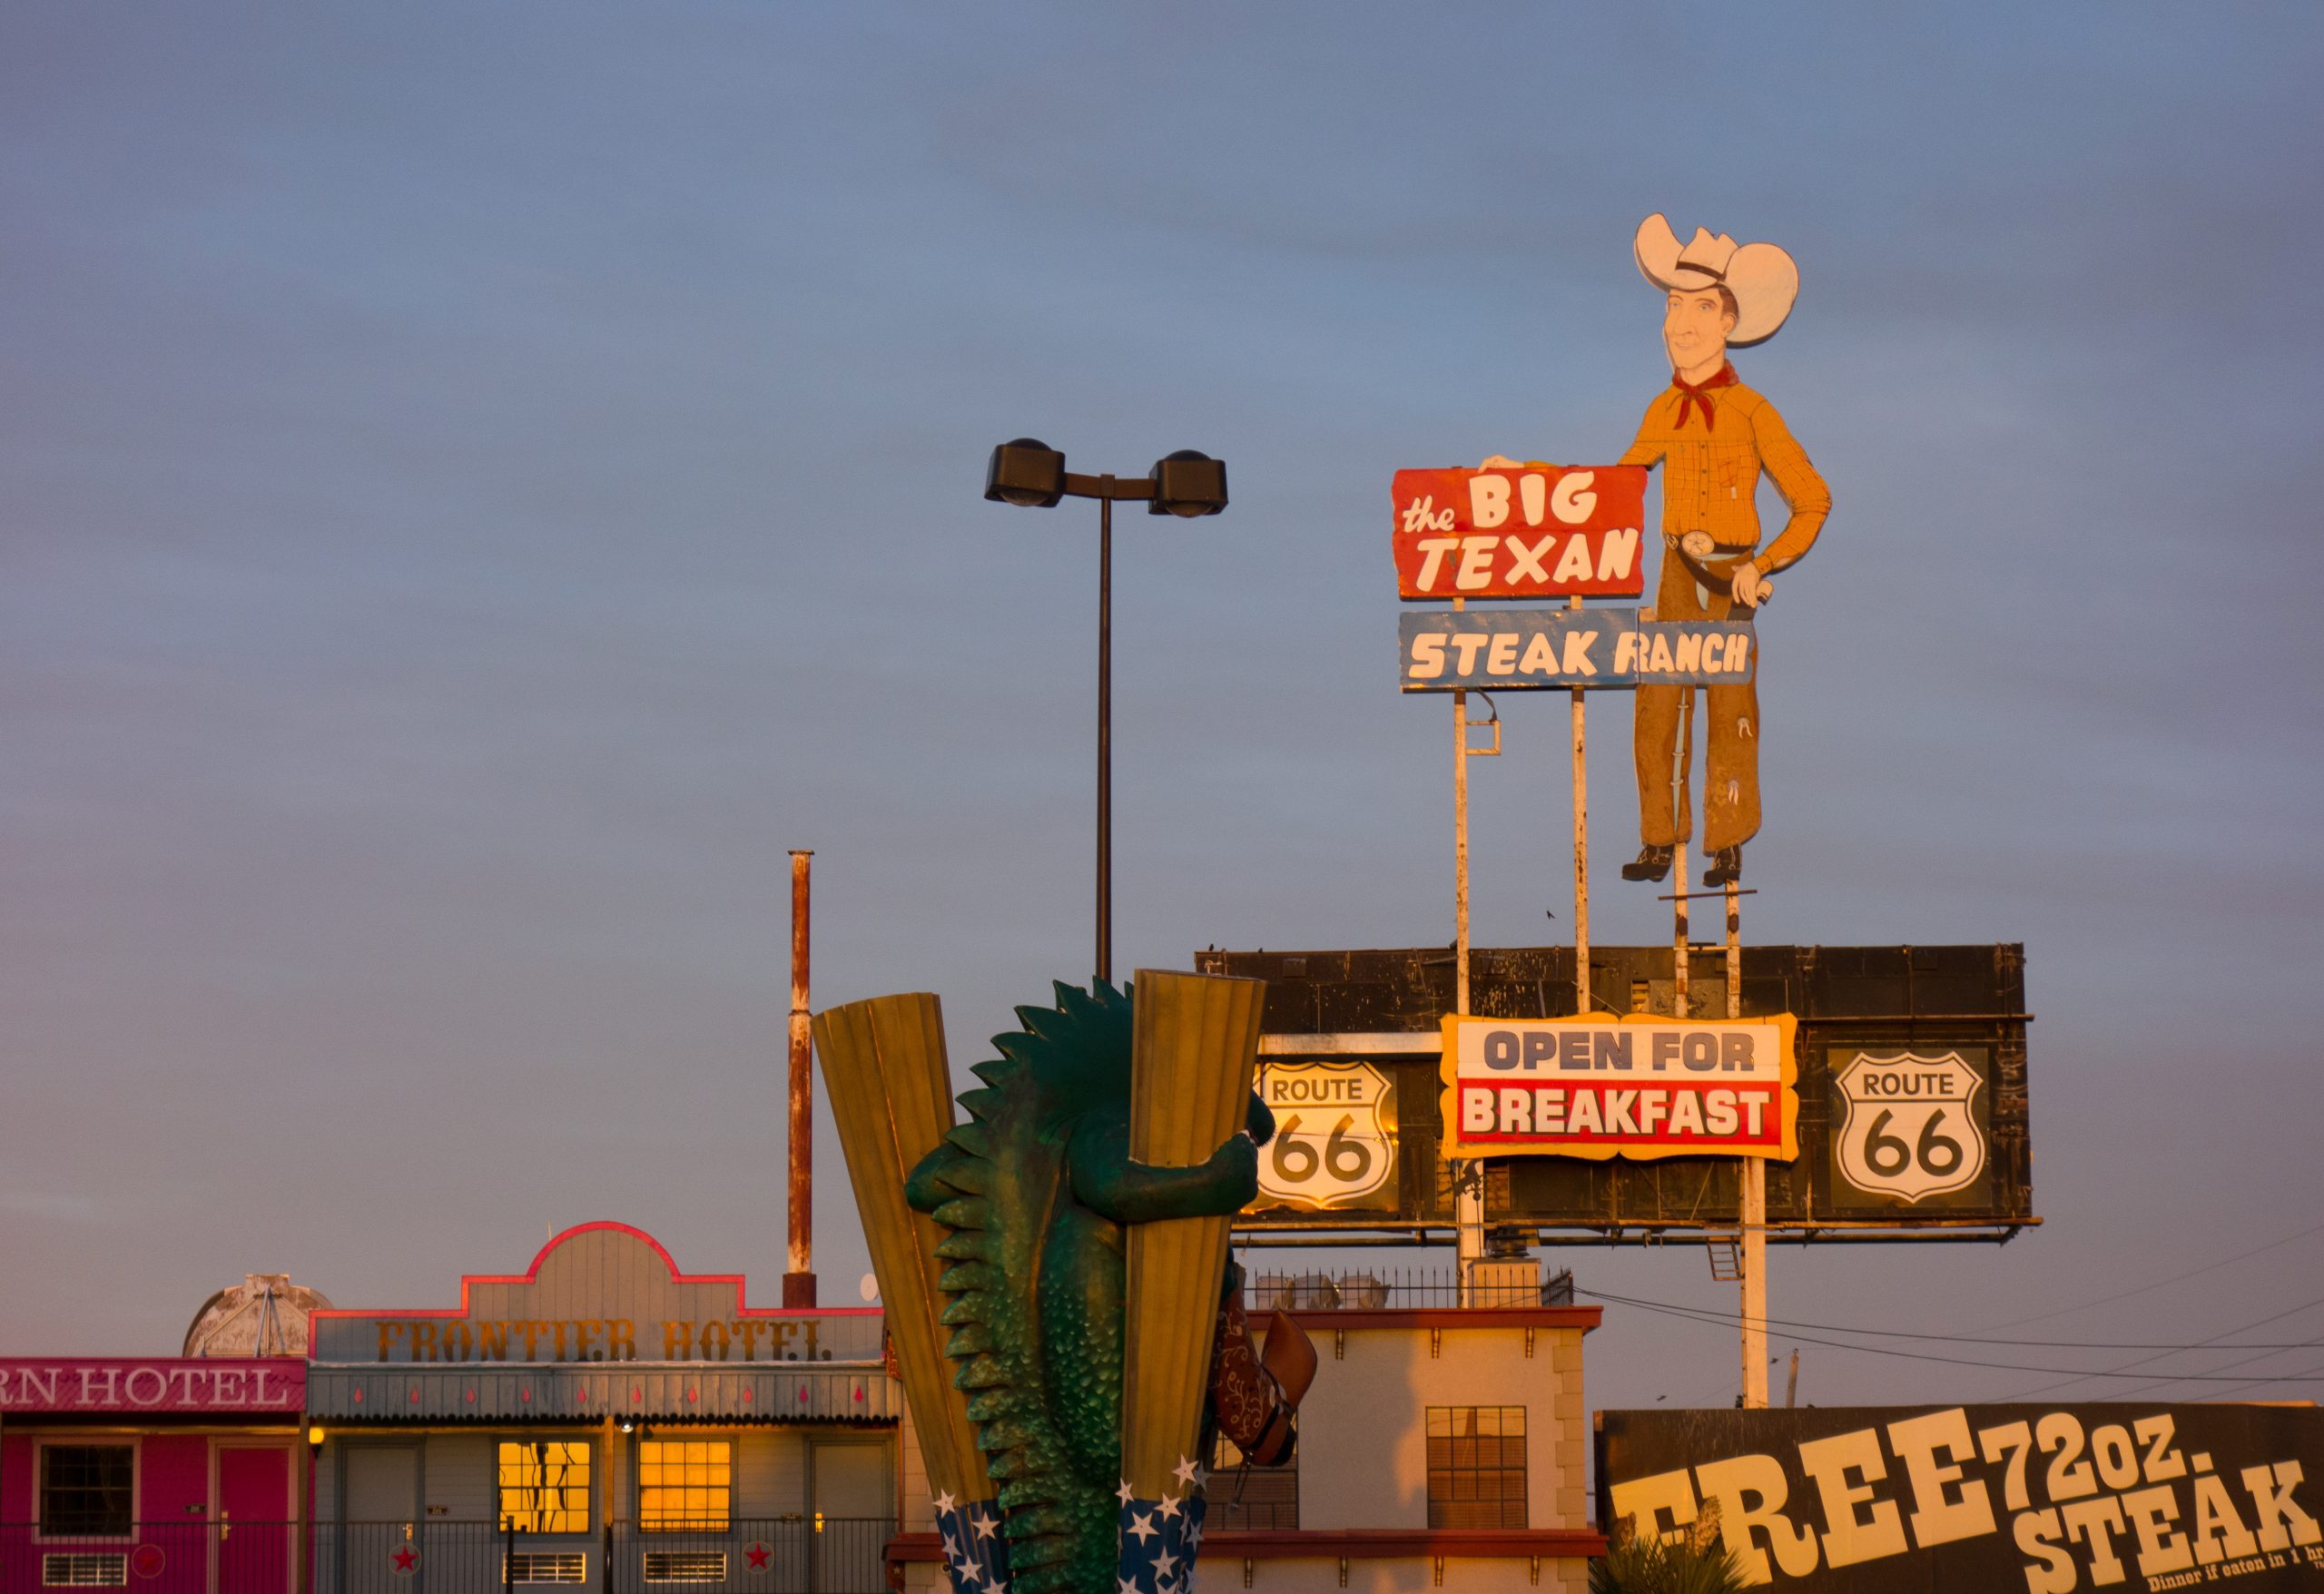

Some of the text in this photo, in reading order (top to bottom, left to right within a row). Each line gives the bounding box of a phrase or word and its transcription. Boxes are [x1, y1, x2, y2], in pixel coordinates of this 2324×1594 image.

[1402, 470, 1598, 534] the BIG
[1415, 527, 1640, 593] TEXAN
[1408, 630, 1749, 679] STEAK RANCH
[1482, 1030, 1756, 1072] OPEN FOR
[1272, 1078, 1363, 1102] ROUTE
[1863, 1073, 1955, 1097] ROUTE
[1462, 1087, 1772, 1137] BREAKFAST
[1271, 1113, 1372, 1182] 66
[1864, 1108, 1964, 1177] 66
[375, 1318, 832, 1363] FRONTIER HOTEL
[74, 1367, 289, 1406] HOTEL
[1610, 1408, 1997, 1589] FREE
[2013, 1460, 2322, 1594] STEAK
[2148, 1571, 2202, 1593] Dinner
[2206, 1563, 2219, 1581] if
[2223, 1558, 2266, 1578] eaten
[2270, 1553, 2286, 1569] in
